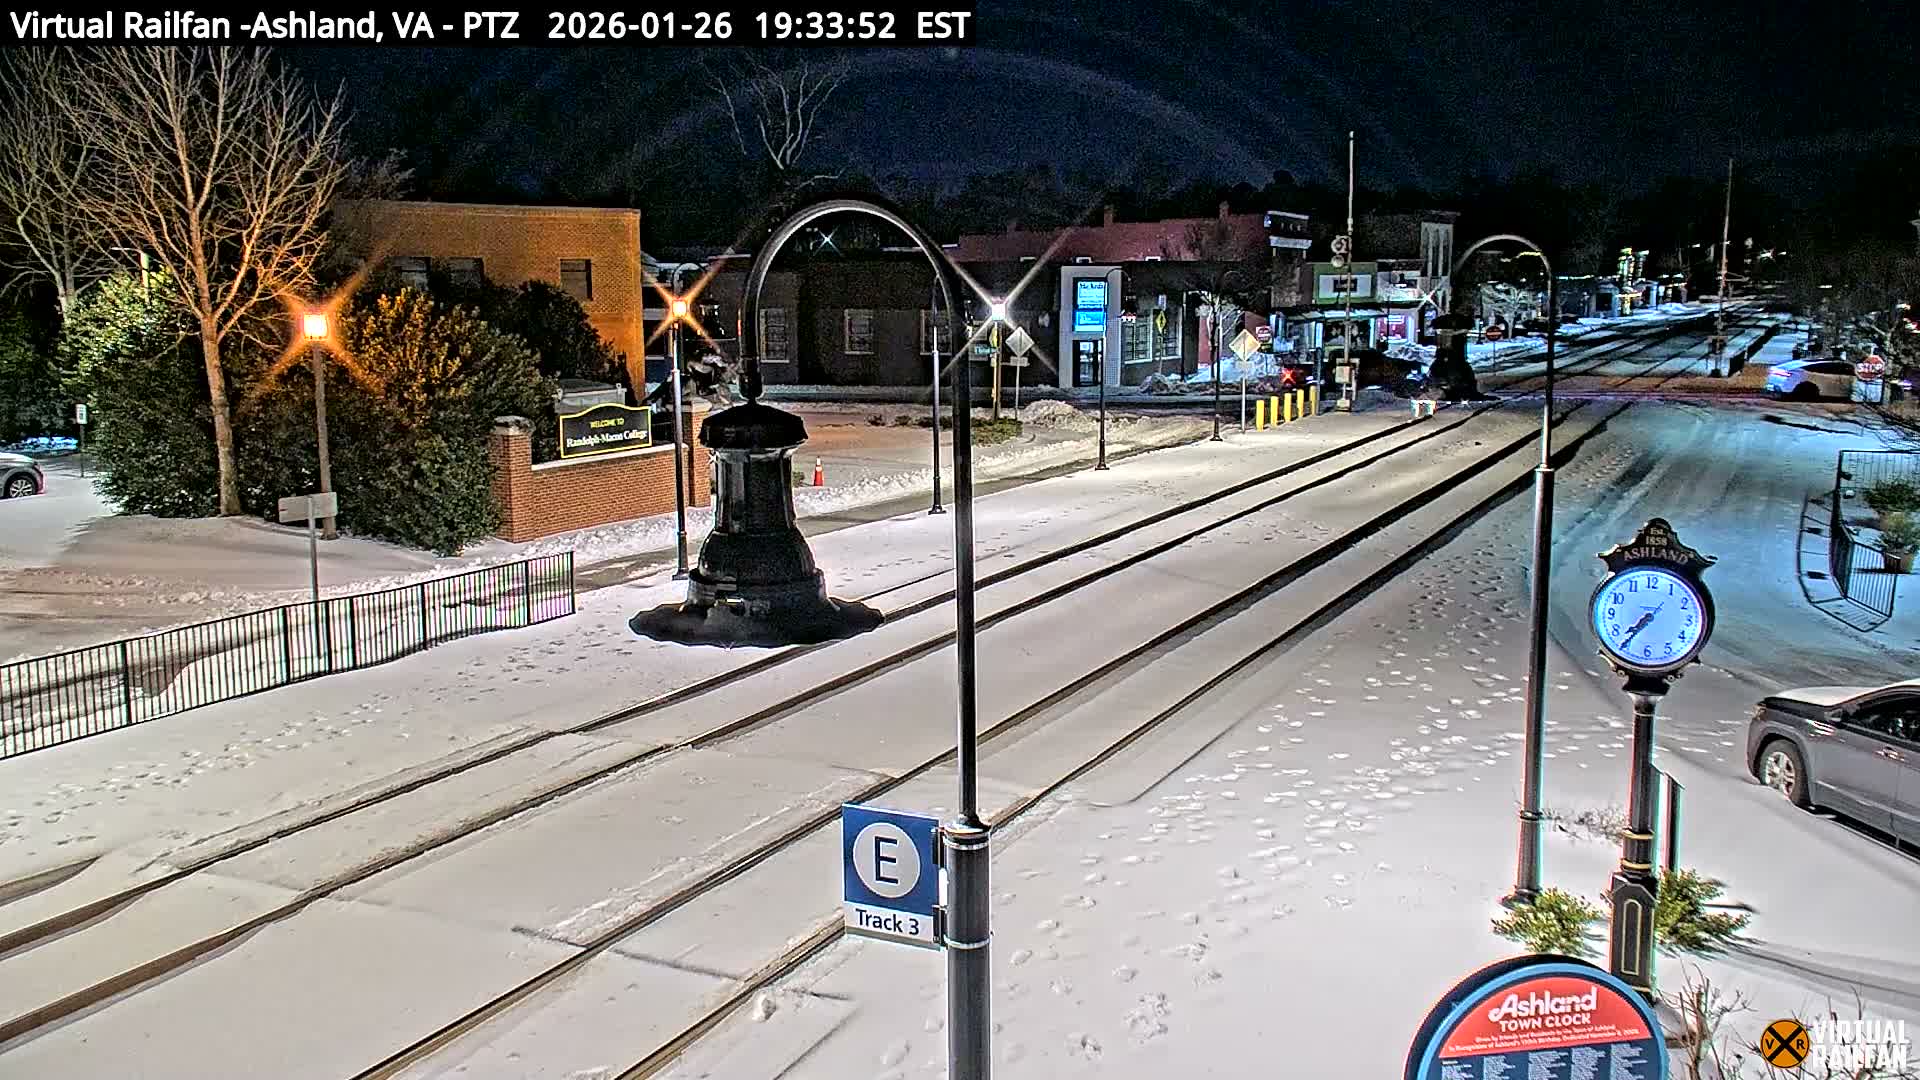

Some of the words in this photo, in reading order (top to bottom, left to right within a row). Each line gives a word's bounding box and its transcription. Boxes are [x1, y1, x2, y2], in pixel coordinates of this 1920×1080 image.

[1856, 362, 1883, 373] STOP
[590, 418, 616, 428] WELCOME
[566, 432, 623, 448] Randolph-Macon
[623, 429, 648, 441] College
[1645, 536, 1668, 546] 1858
[1623, 546, 1689, 565] ASHLAND
[1628, 580, 1638, 593] 11
[1646, 576, 1659, 589] 12
[1668, 583, 1674, 596] 1
[1612, 592, 1625, 605] 10
[1680, 597, 1689, 610] 2
[1607, 607, 1616, 620] 9
[1685, 615, 1694, 627] 3
[1611, 623, 1621, 637] 8
[1677, 630, 1686, 643] 4
[1643, 645, 1652, 657] 6
[1663, 642, 1673, 655] 5
[874, 835, 899, 885] E
[855, 907, 904, 934] Track
[908, 918, 920, 936] 3
[1487, 986, 1598, 1023] Ashland
[1498, 1016, 1543, 1033] TOWN
[1545, 1012, 1592, 1029] CLOCK
